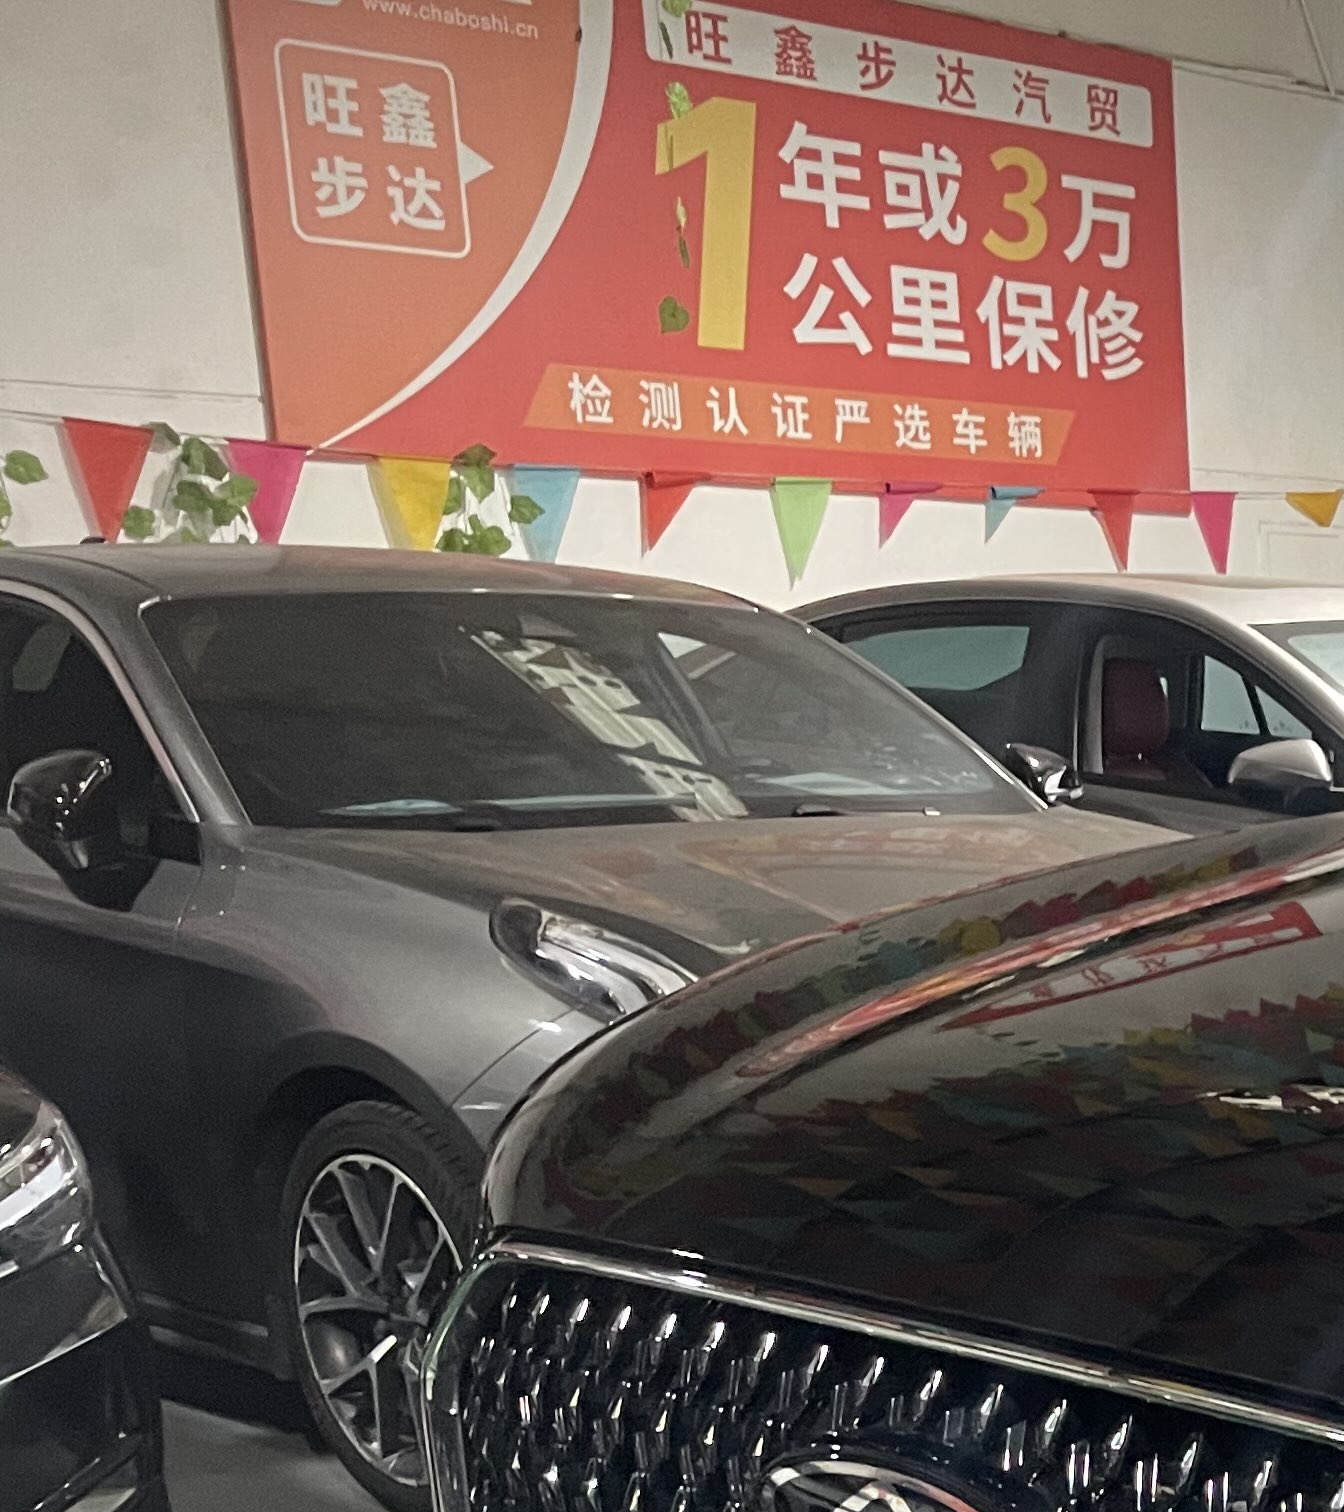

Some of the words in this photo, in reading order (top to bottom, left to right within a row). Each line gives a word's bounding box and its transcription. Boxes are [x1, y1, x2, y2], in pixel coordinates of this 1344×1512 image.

[361, 0, 540, 41] www.chaboshi.cn
[301, 72, 438, 150] 旺鑫
[684, 8, 1123, 138] 旺鑫步达汽贸
[310, 155, 447, 232] 步达
[655, 97, 757, 351] 1
[783, 252, 1146, 382] 公里保修
[567, 373, 1044, 460] 检测认证严选车辆
